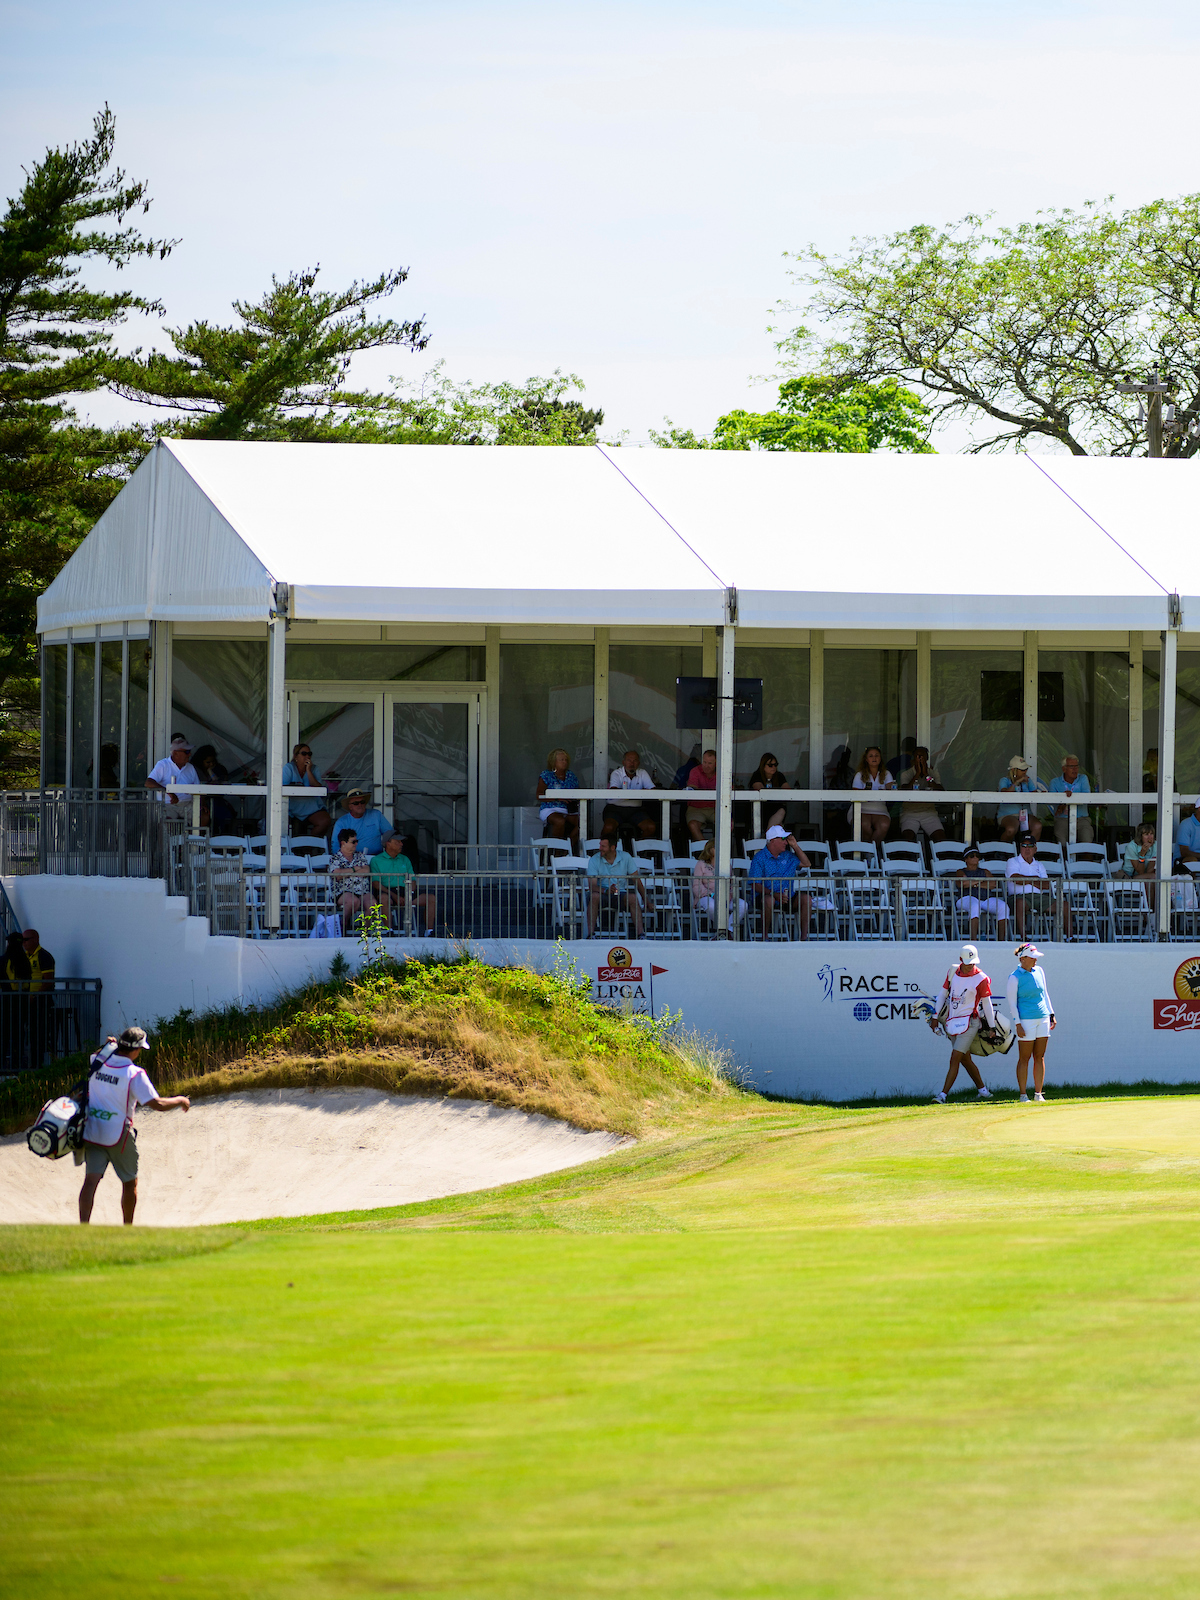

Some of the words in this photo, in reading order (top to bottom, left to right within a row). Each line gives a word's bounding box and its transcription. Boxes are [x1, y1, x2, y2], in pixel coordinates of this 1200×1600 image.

[600, 969, 640, 982] ShopRite
[840, 975, 899, 992] RACE
[903, 983, 919, 992] TO
[596, 985, 646, 999] LPGA
[875, 1003, 920, 1020] CME
[89, 1107, 118, 1121] acer
